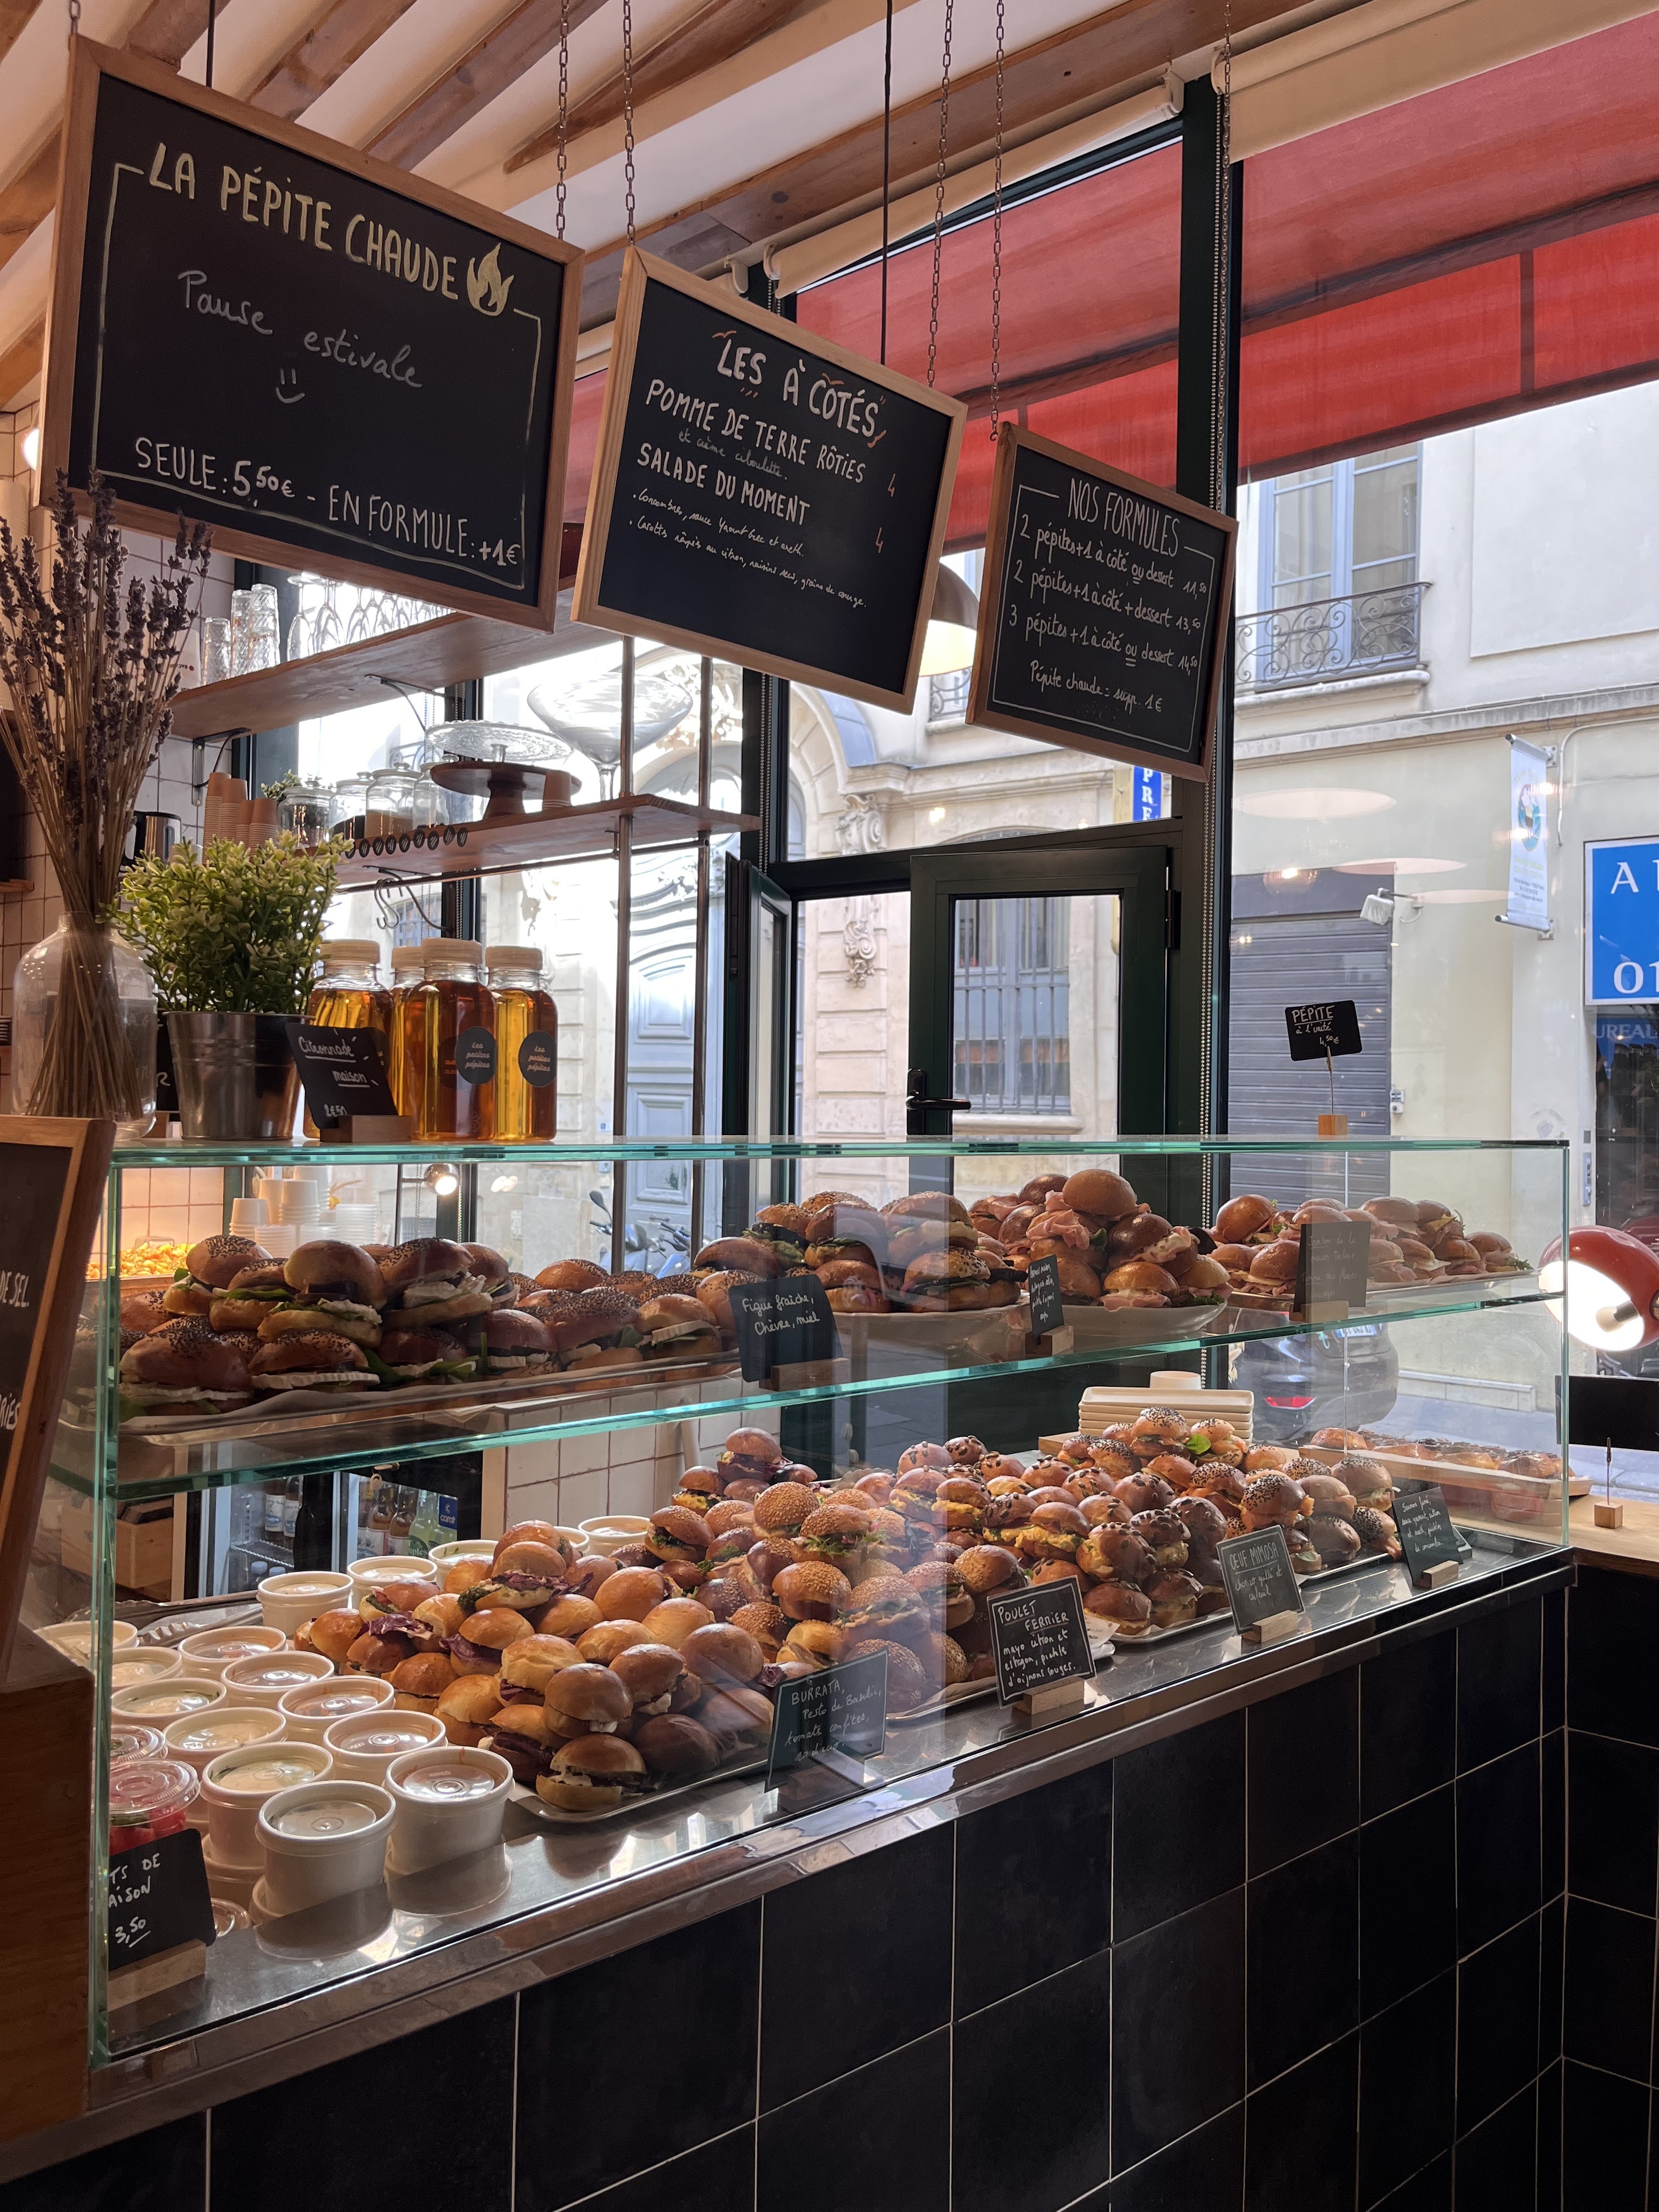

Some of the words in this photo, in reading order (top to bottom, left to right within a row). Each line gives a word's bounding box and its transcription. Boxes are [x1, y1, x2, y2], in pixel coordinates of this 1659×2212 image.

[148, 142, 195, 199] LA
[346, 213, 459, 300] CHAUDE
[178, 269, 273, 335] Pause
[304, 328, 420, 388] estivale
[717, 338, 766, 385] LES
[783, 359, 806, 406] À
[646, 379, 719, 432] POMME
[721, 408, 750, 441] DE
[756, 420, 811, 465] TERRE
[888, 473, 896, 497] 4
[329, 484, 360, 526] EN
[637, 442, 708, 488] SALADE
[714, 469, 737, 500] DU
[741, 479, 810, 526] MOMENT
[875, 527, 883, 554] 4
[1068, 478, 1100, 523] NOS
[1104, 492, 1180, 557] FORMULES
[769, 536, 779, 546] et
[1020, 514, 1030, 539] 2
[1034, 522, 1076, 564] pépites
[1095, 540, 1104, 563] à
[1106, 548, 1130, 572] côté
[1132, 563, 1145, 577] ou
[1146, 562, 1174, 589] dessert
[706, 545, 716, 554] au
[826, 584, 834, 594] de
[1014, 559, 1023, 584] 2
[1030, 567, 1072, 604] pépites
[1091, 582, 1101, 605] à
[1102, 588, 1124, 612] côté
[1009, 603, 1018, 627] 3
[1025, 612, 1067, 647] pépites
[1091, 626, 1101, 647] à
[1101, 630, 1125, 653] côté
[1125, 644, 1137, 657] ou
[1141, 648, 1173, 668] dessert
[1030, 659, 1062, 693] Pépite
[1296, 1026, 1302, 1034] à
[1305, 1022, 1331, 1034] l'unité
[298, 1035, 355, 1058] Citronnade
[332, 1068, 368, 1084] maison
[742, 1297, 773, 1317] Figue
[796, 1310, 820, 1325] miel
[440, 1514, 456, 1524] carat
[997, 1600, 1036, 1624] POULET
[1003, 1644, 1025, 1657] mayo
[1031, 1633, 1054, 1648] citron
[1058, 1628, 1068, 1641] et
[803, 1702, 827, 1720] Pesto
[831, 1699, 843, 1712] de
[142, 1853, 161, 1871] DE
[115, 1916, 146, 1944] 3,50
